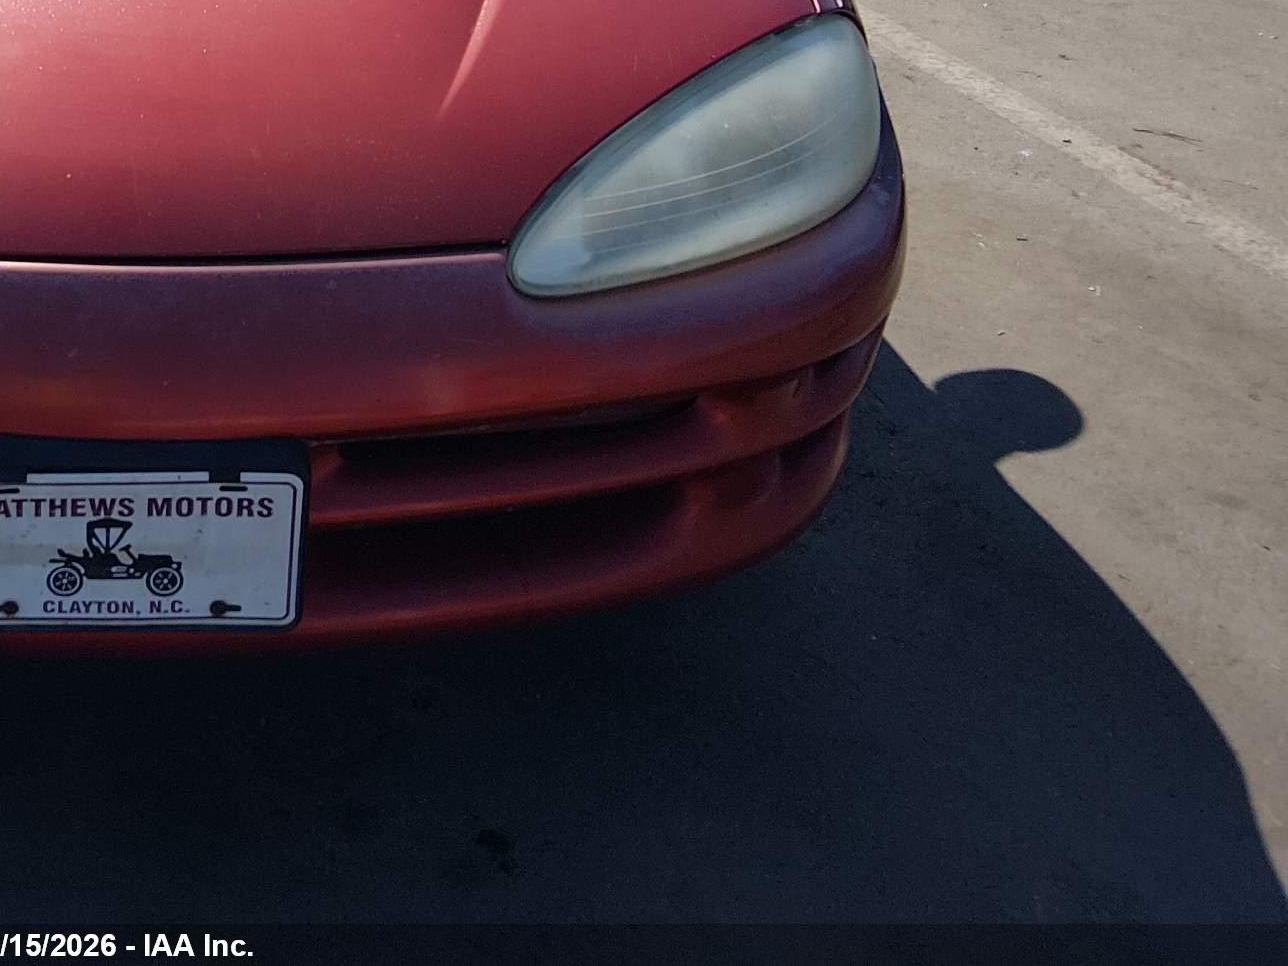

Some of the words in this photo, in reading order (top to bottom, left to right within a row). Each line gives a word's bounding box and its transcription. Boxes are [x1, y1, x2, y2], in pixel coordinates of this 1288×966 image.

[147, 497, 275, 517] MOTORS
[42, 600, 141, 615] CLAYTON,
[149, 599, 191, 614] N.C.
